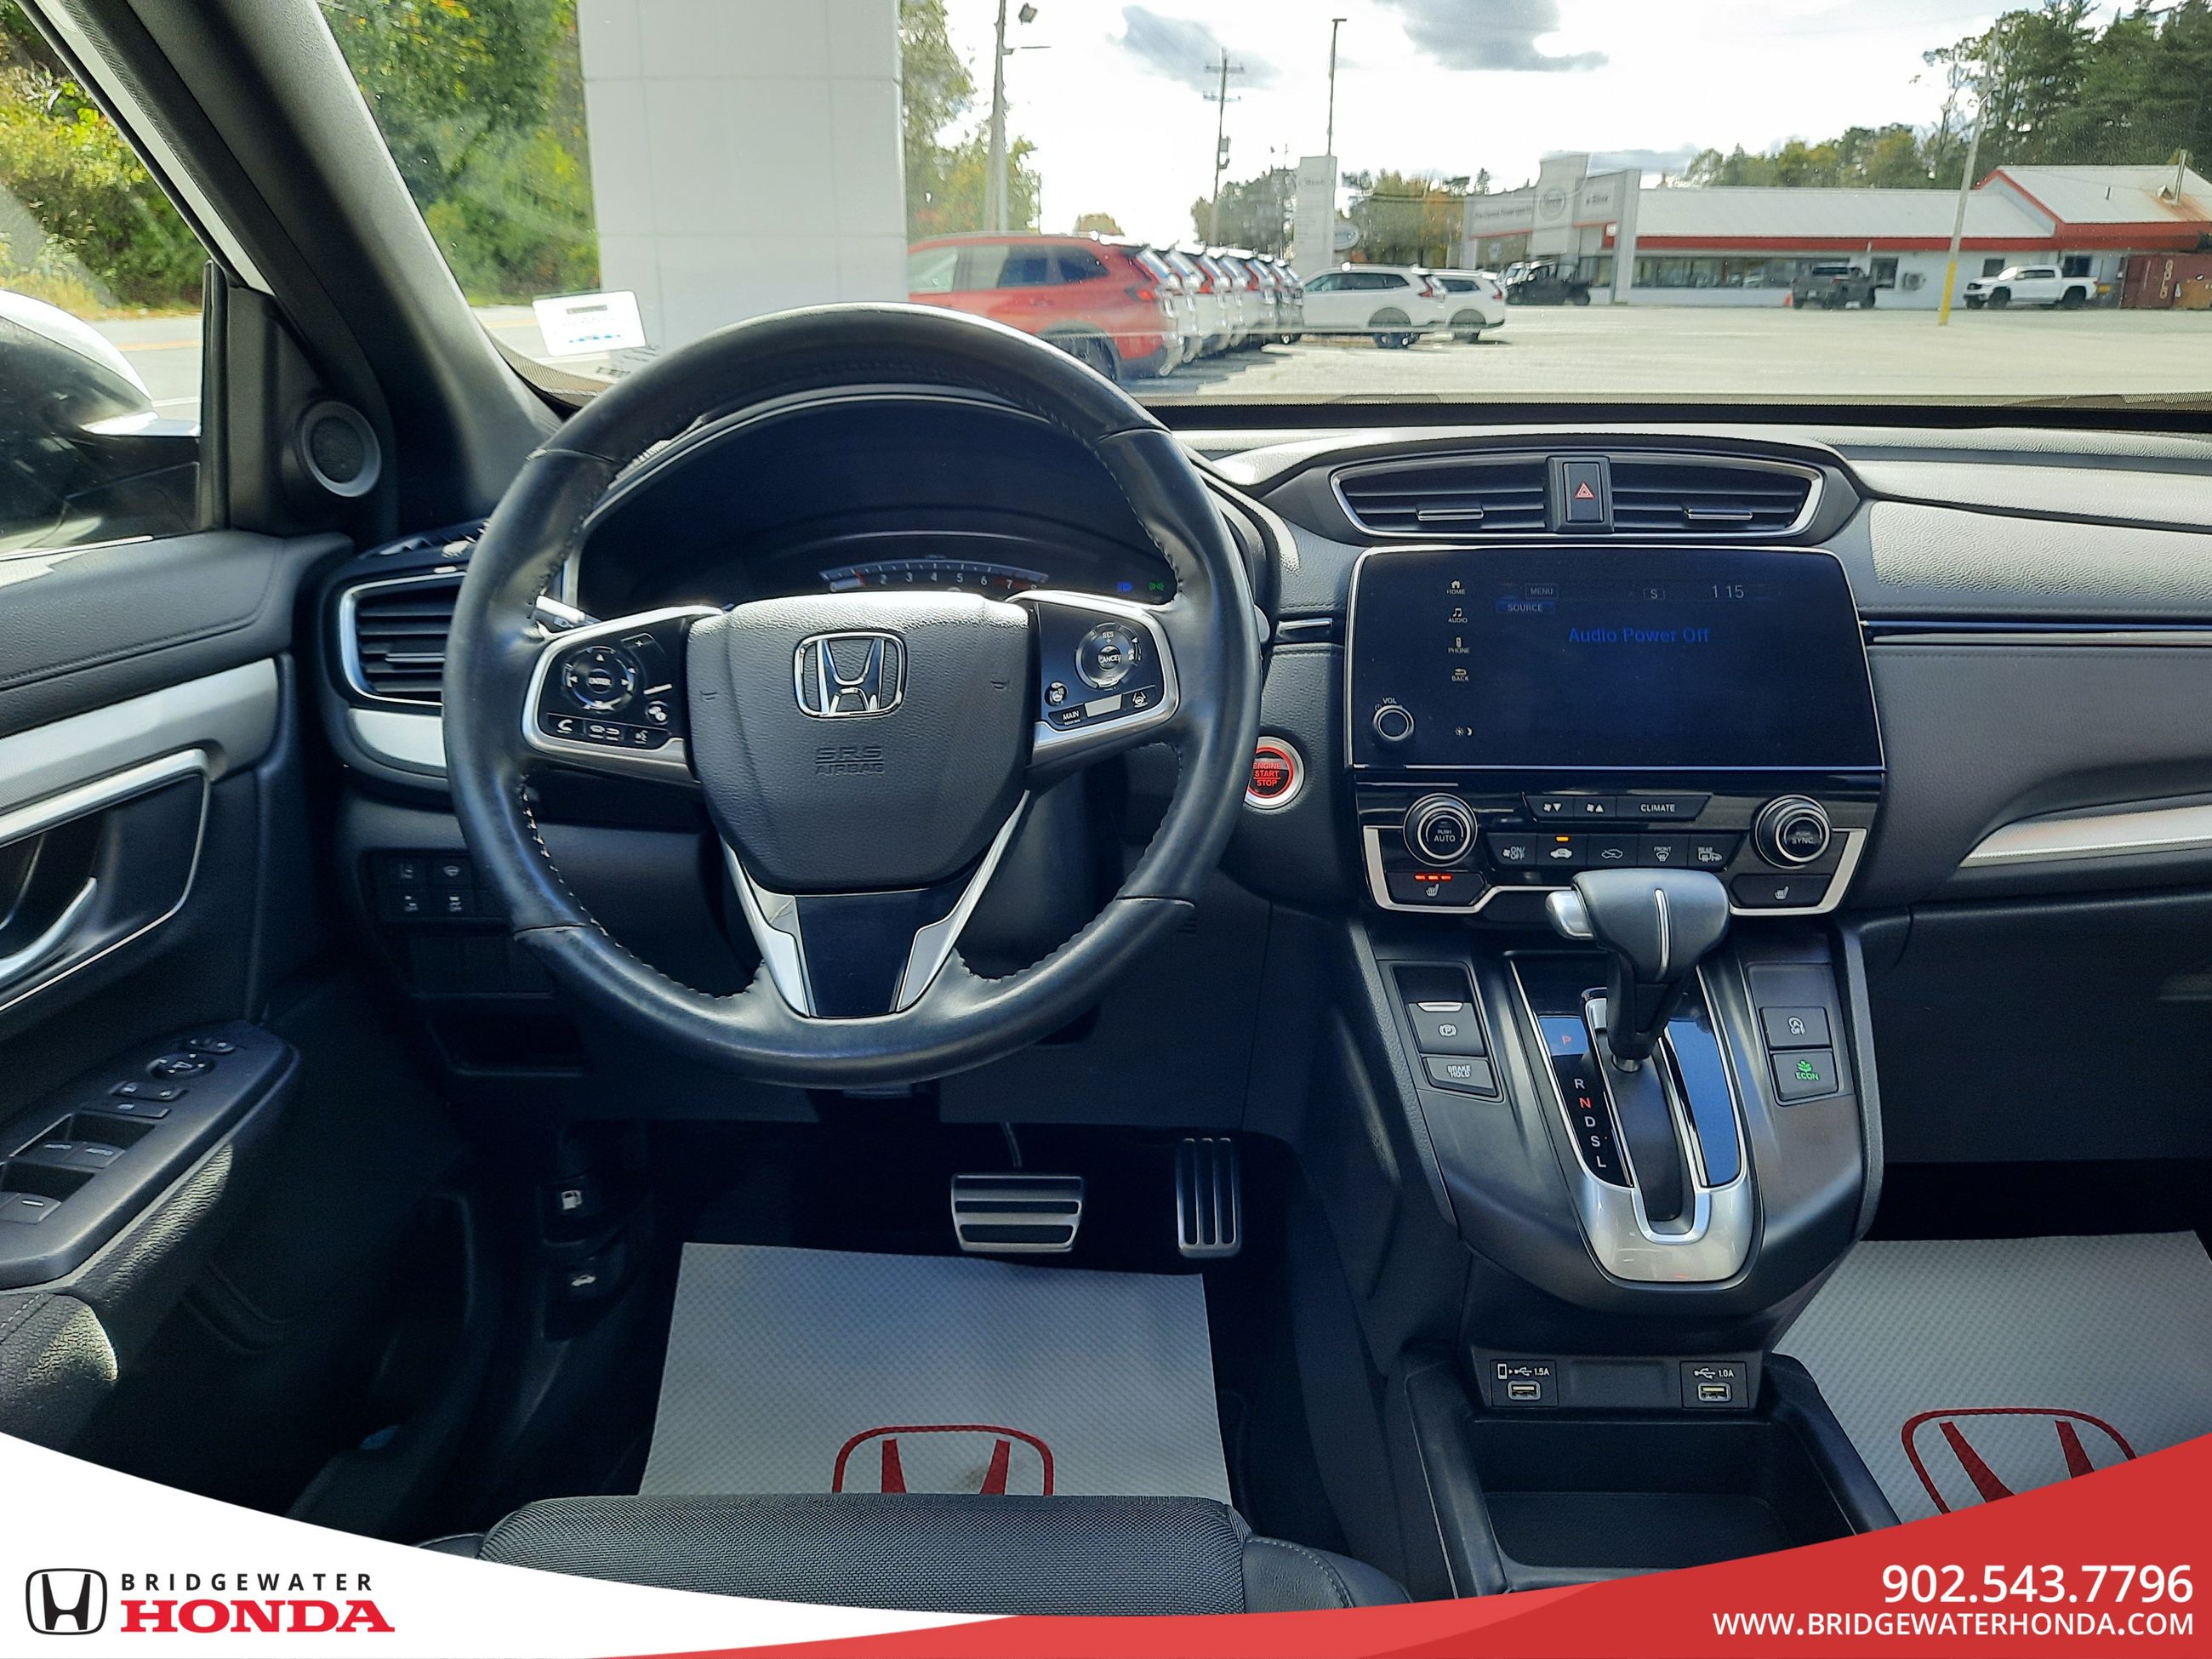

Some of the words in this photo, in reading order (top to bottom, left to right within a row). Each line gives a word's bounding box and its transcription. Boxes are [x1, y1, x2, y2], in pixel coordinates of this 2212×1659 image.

[906, 573, 914, 583] 3
[956, 573, 964, 583] 5
[980, 575, 988, 585] 6
[1006, 579, 1013, 590] 7
[1508, 603, 1543, 613] SOURCE
[1569, 626, 1617, 642] Audio
[1622, 626, 1677, 642] Power
[1683, 625, 1712, 642] Off
[1063, 710, 1080, 721] MAIN
[816, 745, 883, 760] SRS
[815, 763, 885, 775] AIRBAG
[1640, 803, 1675, 812] CLIMATE
[1562, 1035, 1571, 1045] P
[1795, 1072, 1820, 1080] ECON
[1574, 1078, 1586, 1090] R
[1578, 1097, 1592, 1109] N
[1584, 1116, 1596, 1127] D
[1590, 1135, 1601, 1147] S
[1596, 1155, 1607, 1168] L
[1534, 1367, 1550, 1377] 1.5A
[1718, 1369, 1734, 1378] 1.0A
